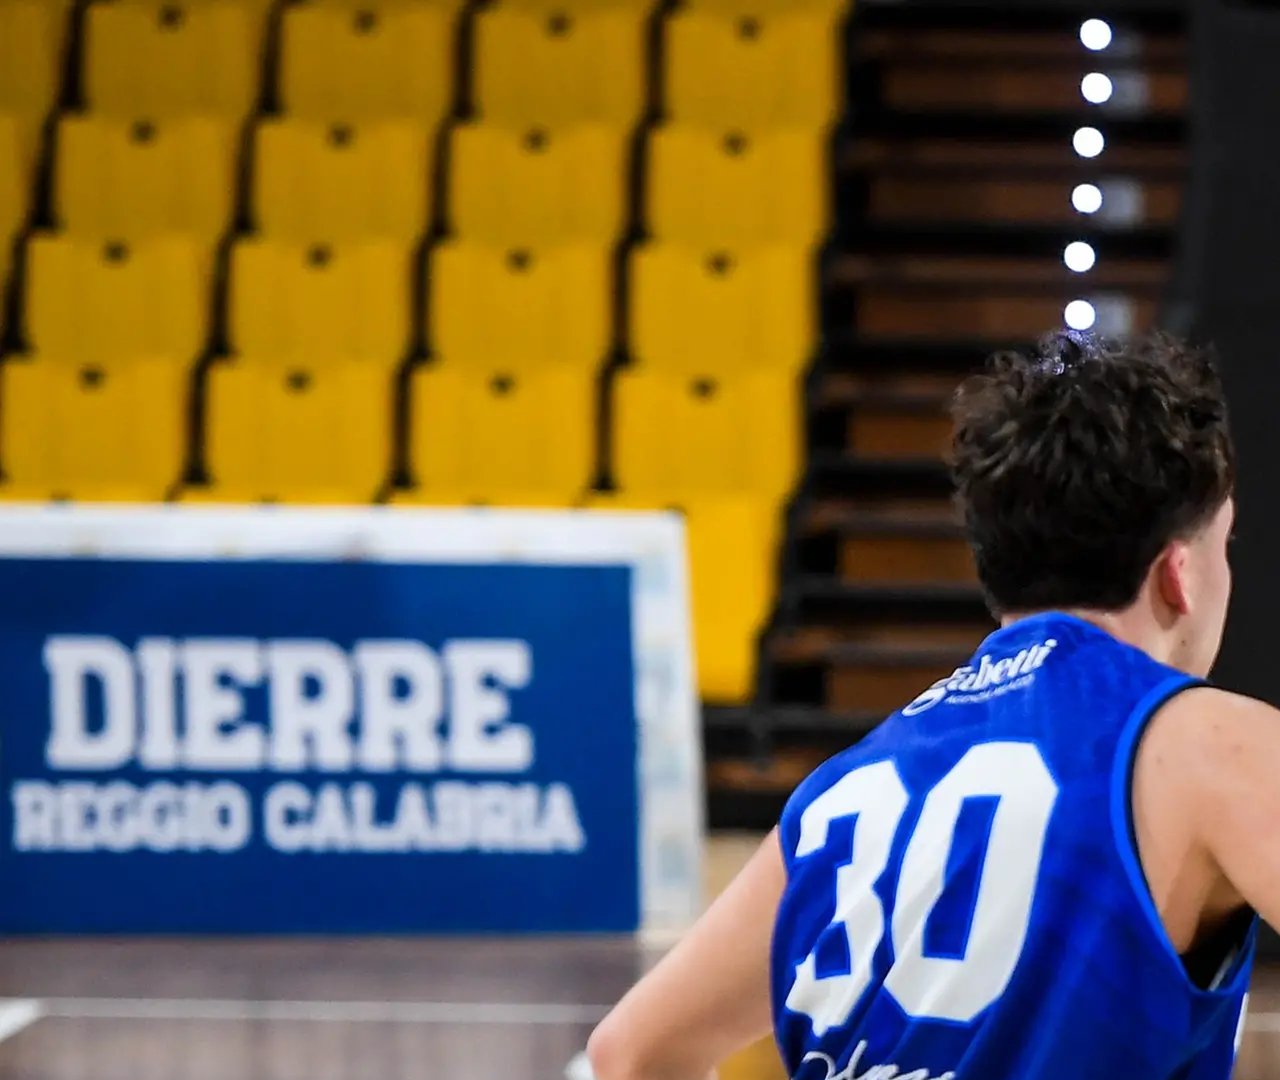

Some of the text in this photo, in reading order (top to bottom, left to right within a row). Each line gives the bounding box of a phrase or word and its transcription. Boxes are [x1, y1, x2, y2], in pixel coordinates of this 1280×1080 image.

[44, 635, 534, 772] DIERRE
[12, 781, 587, 854] REGGIO CALABRIA
[785, 741, 1059, 1038] 30
